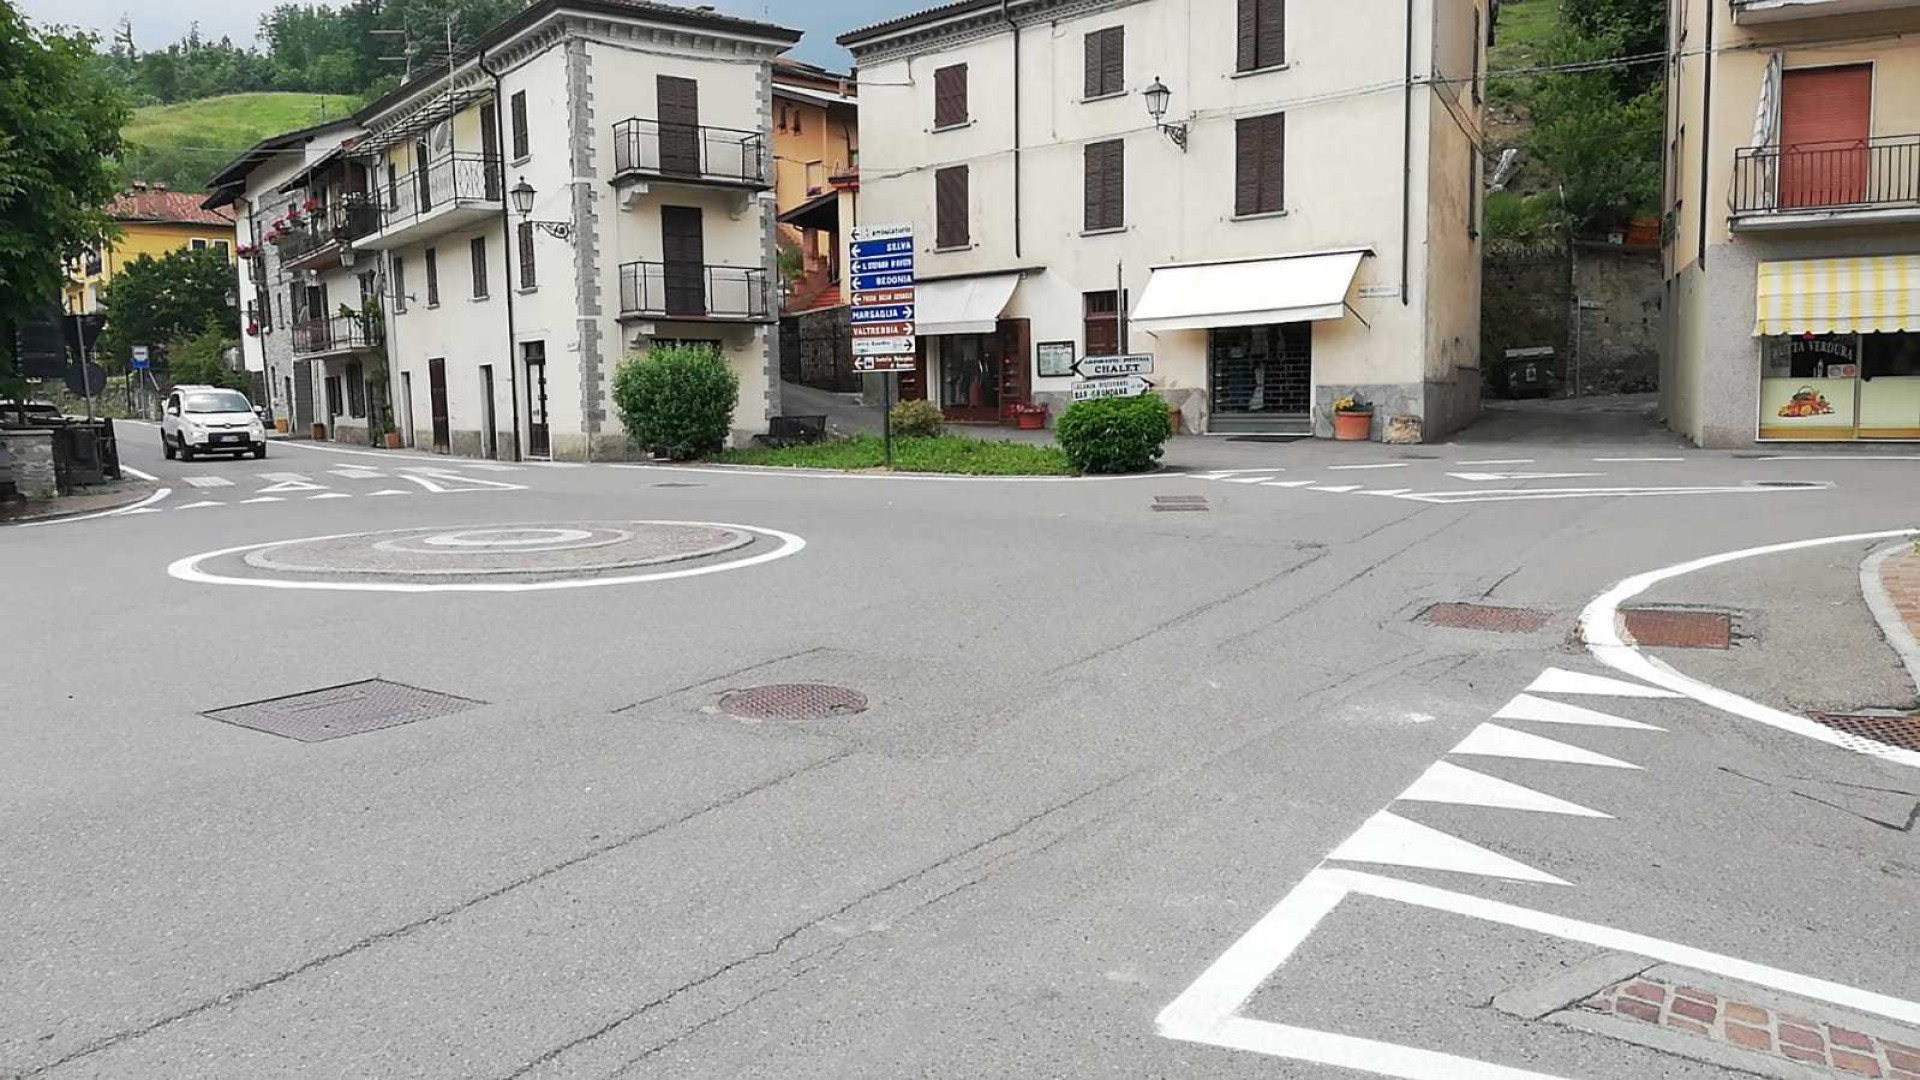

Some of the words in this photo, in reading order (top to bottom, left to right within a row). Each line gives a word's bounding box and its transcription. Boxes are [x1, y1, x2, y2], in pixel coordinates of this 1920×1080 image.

[886, 241, 911, 251] SELVA
[876, 274, 912, 286] BEDONIA
[852, 308, 898, 320] MARSAGLIA
[853, 325, 899, 336] VALTREBBIA
[1809, 340, 1853, 361] VERDURA
[1094, 363, 1140, 374] CHALET
